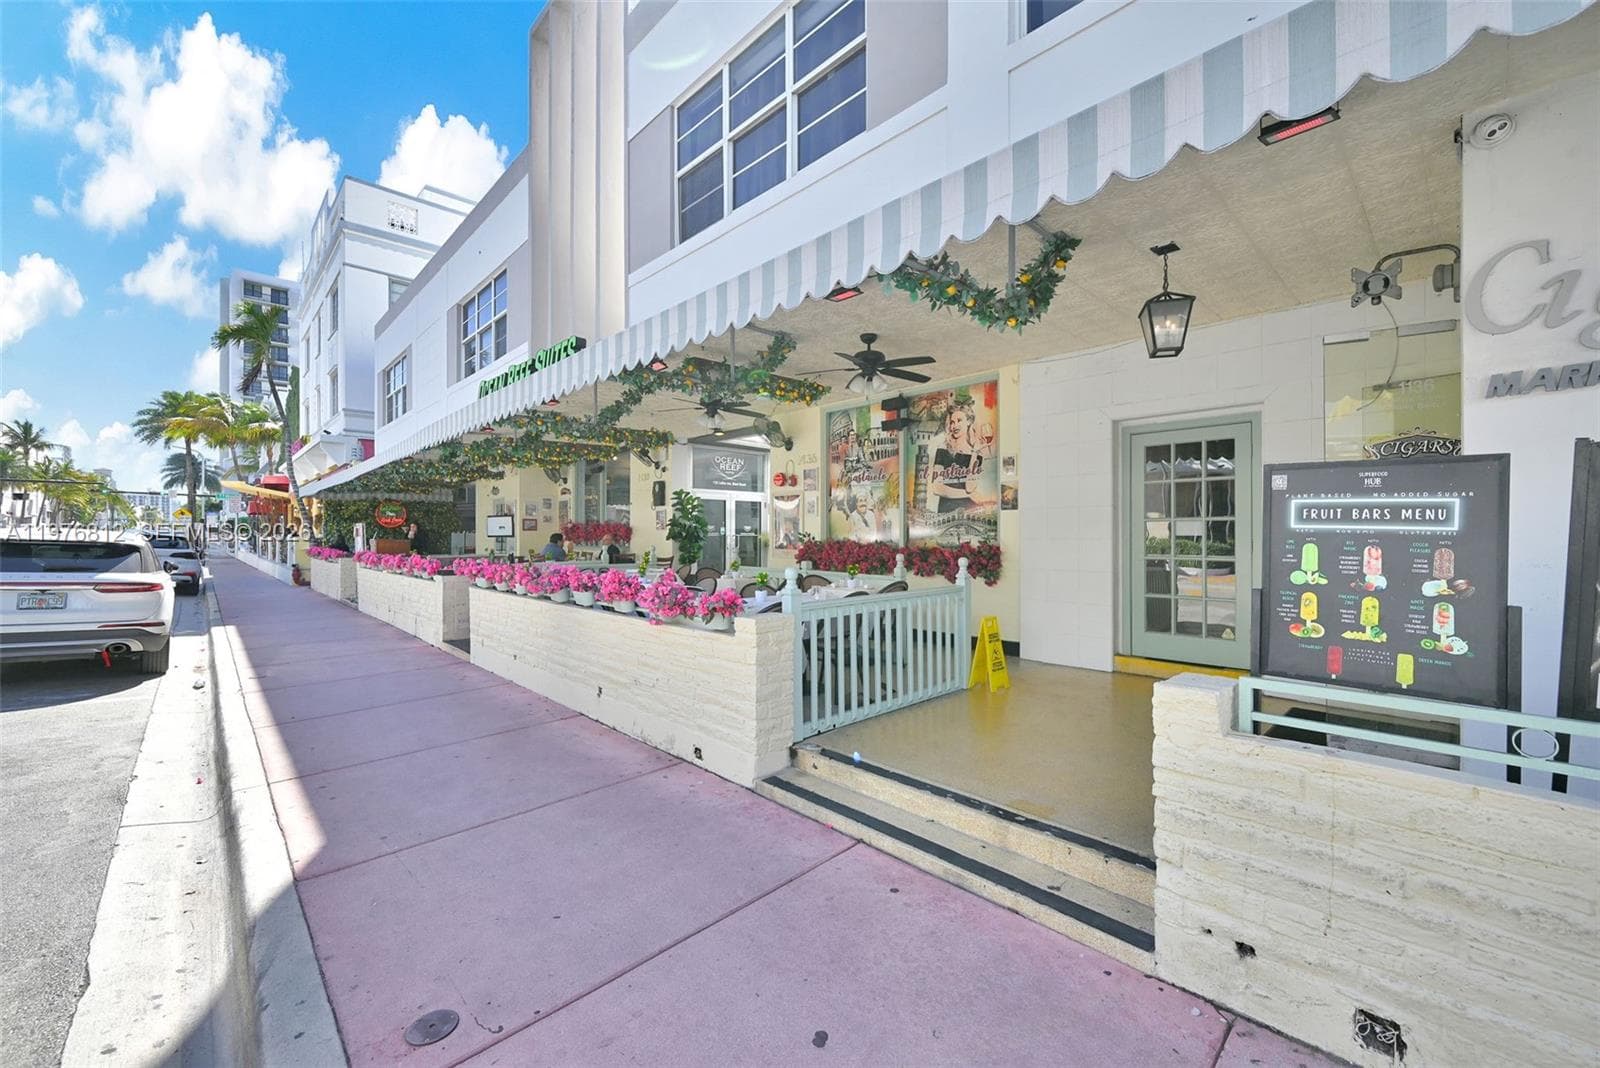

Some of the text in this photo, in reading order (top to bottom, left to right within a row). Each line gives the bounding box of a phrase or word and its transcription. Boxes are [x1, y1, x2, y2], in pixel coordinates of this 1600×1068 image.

[1465, 239, 1600, 350] Ci
[535, 335, 579, 371] SUITES
[1380, 440, 1453, 458] CIGARS
[715, 456, 744, 465] OCEAN
[720, 463, 742, 471] REEF
[931, 459, 983, 483] pastaiolo
[1303, 508, 1447, 520] FRUIT BARS MENU
